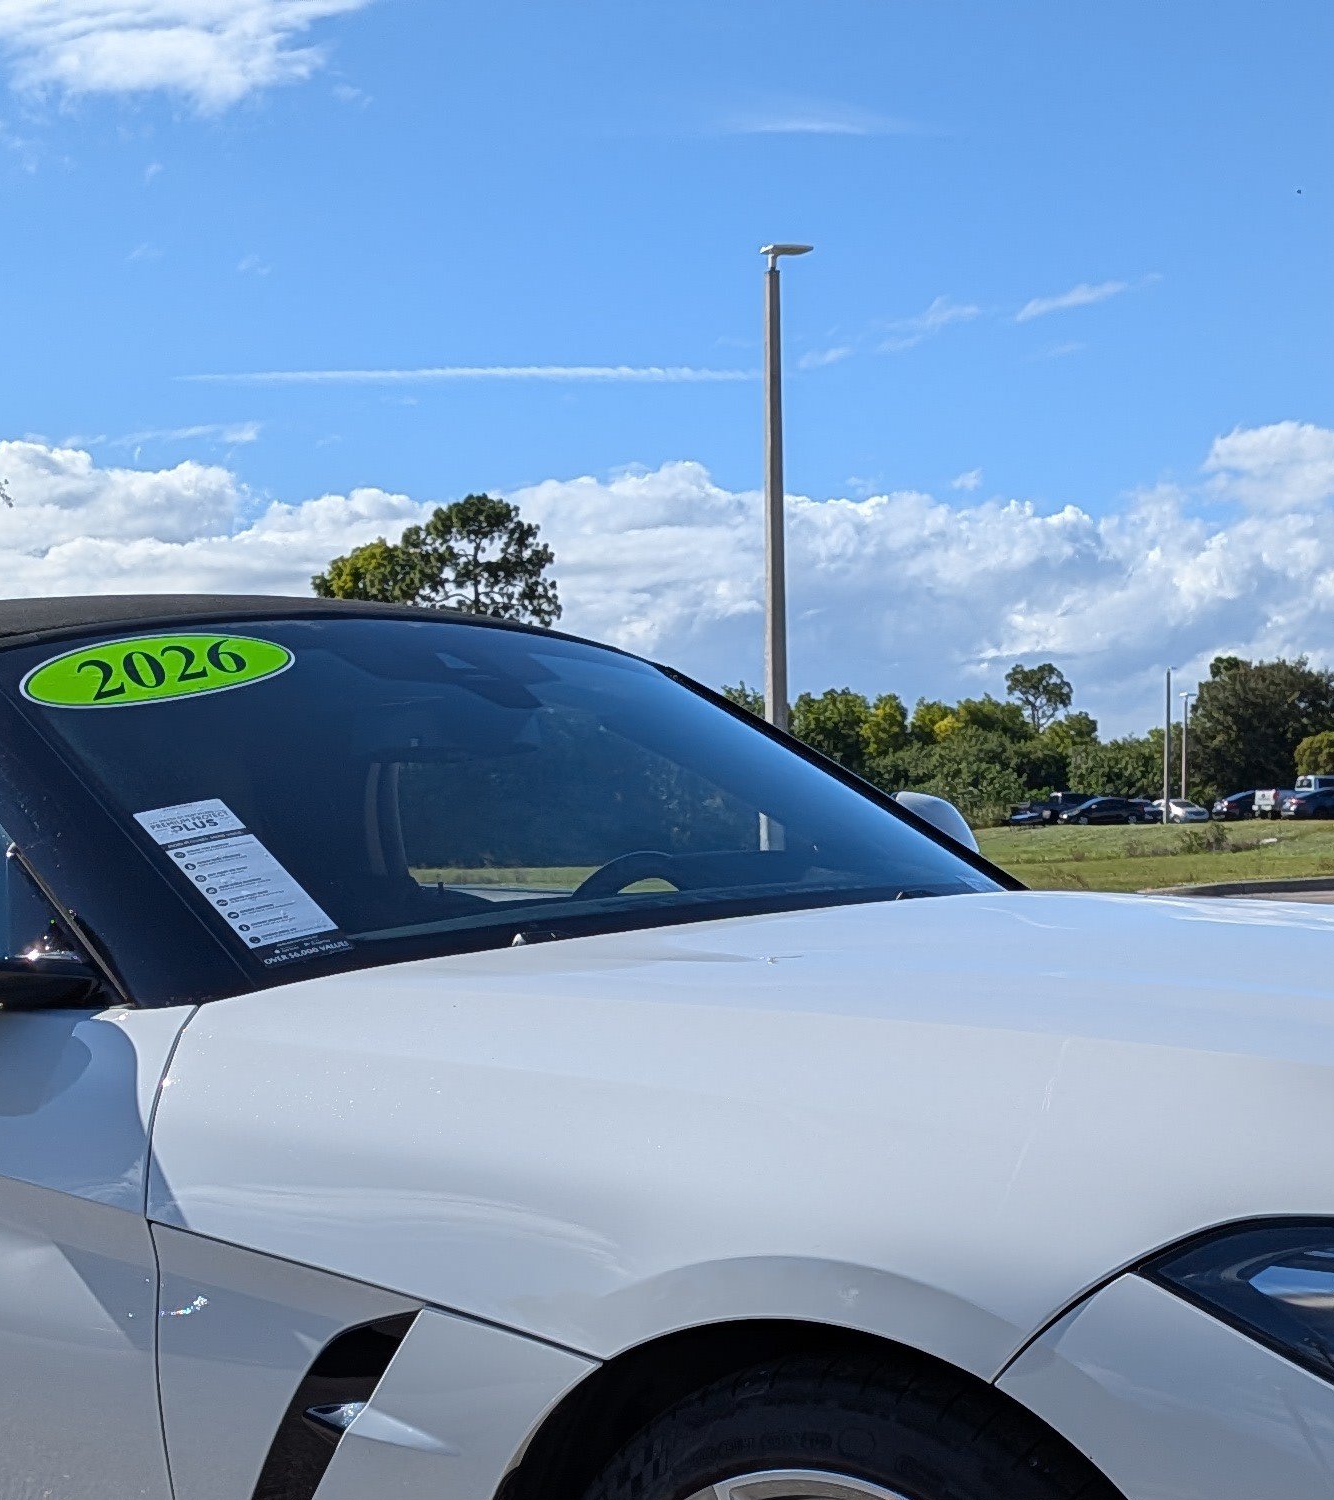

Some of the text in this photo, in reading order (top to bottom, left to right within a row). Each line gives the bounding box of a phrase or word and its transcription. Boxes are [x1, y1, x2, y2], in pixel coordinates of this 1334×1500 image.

[77, 639, 247, 701] 2026
[150, 816, 191, 831] PREMIUM
[191, 810, 229, 822] PROTECT
[264, 954, 289, 965] OVER
